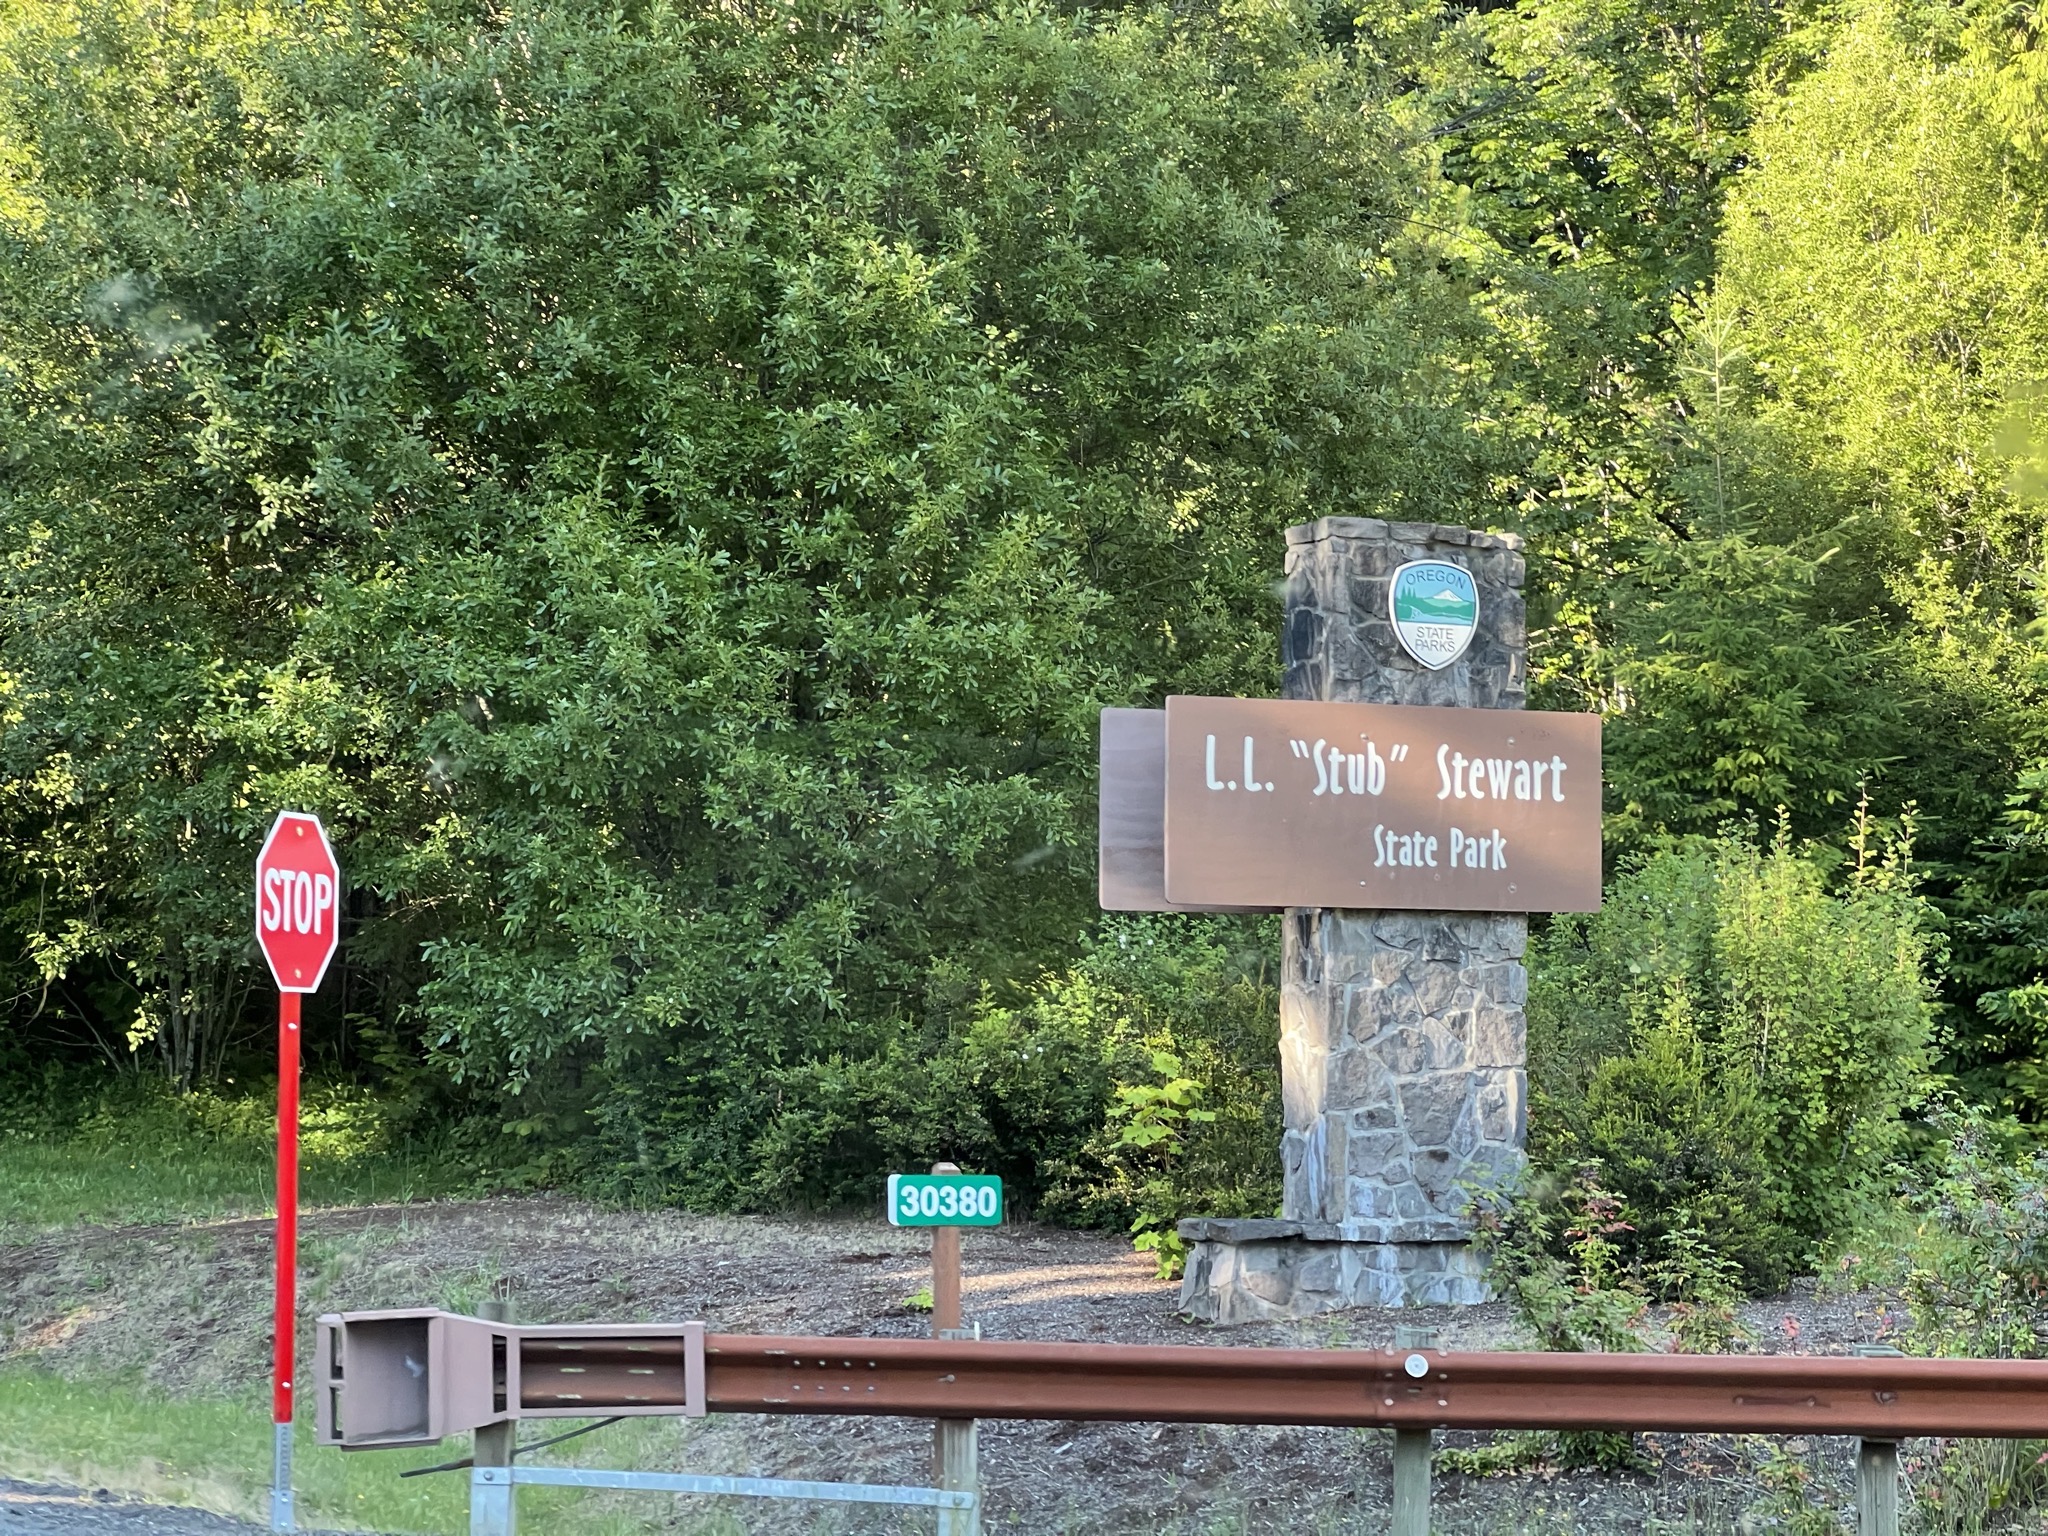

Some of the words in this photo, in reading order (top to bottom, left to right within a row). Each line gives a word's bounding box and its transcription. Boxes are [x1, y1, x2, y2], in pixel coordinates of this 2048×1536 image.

[1406, 569, 1466, 589] OREGON
[1415, 639, 1455, 653] PARKS
[1416, 626, 1454, 640] STATE
[1205, 734, 1275, 793] L.L.
[1436, 743, 1568, 802] Stewart
[1373, 823, 1439, 869] State
[1449, 827, 1508, 871] Park
[262, 867, 333, 935] STOP
[900, 1185, 997, 1217] 30380
